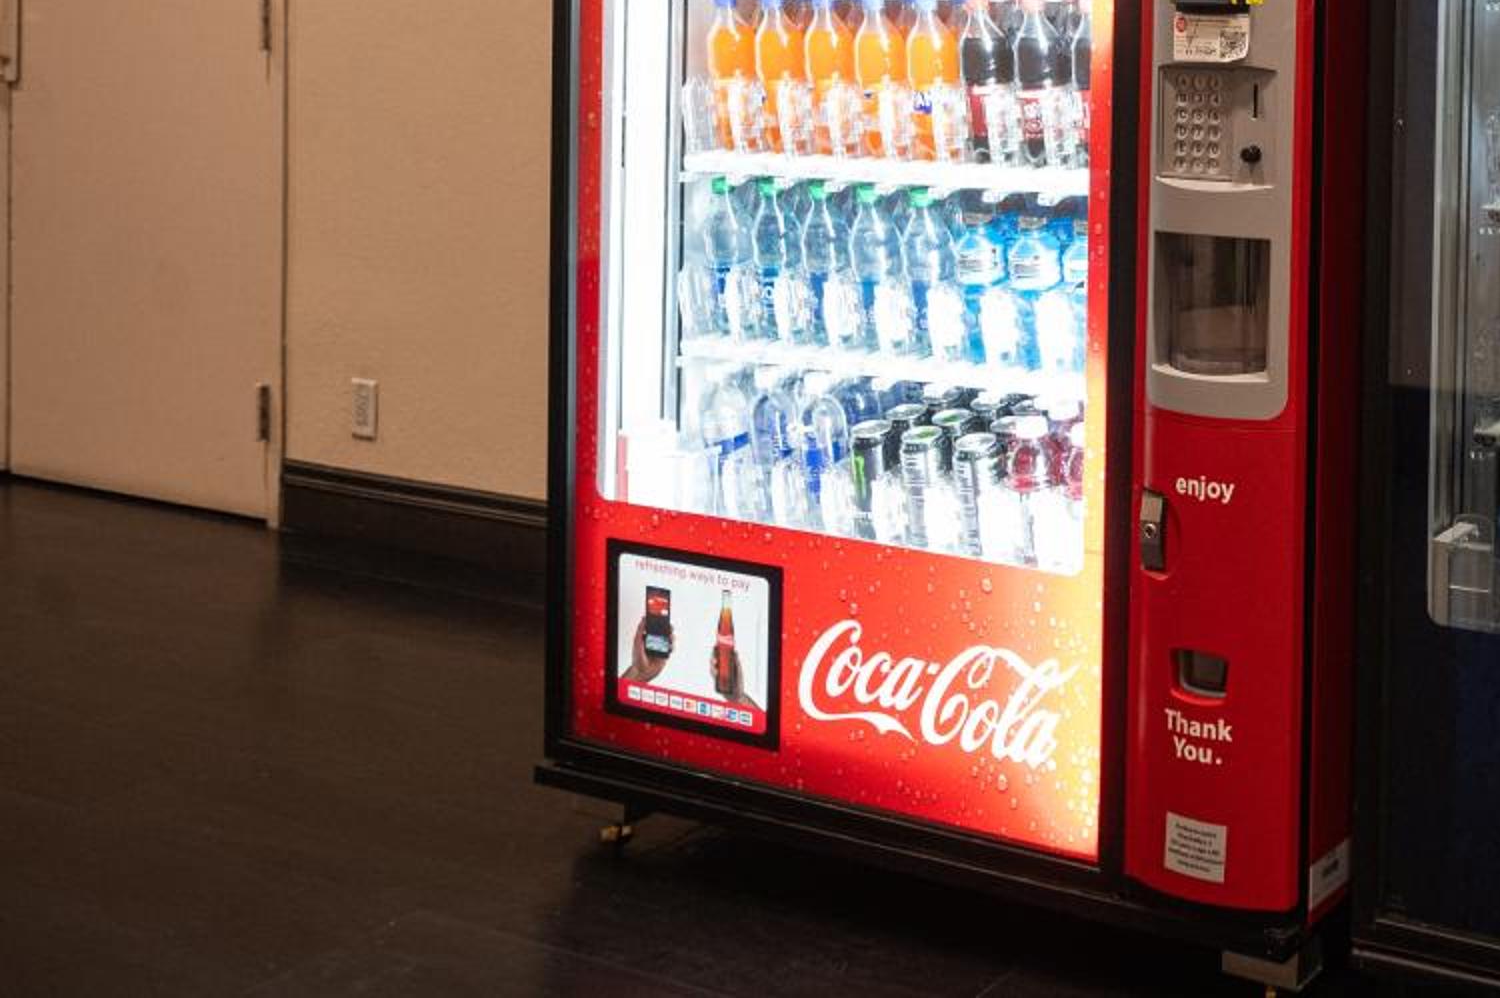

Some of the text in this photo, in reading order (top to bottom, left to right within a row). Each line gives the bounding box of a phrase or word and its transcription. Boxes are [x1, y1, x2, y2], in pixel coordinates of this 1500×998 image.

[1175, 475, 1235, 504] enjoy
[798, 619, 1082, 770] Coca-Cola
[1165, 708, 1233, 743] Thank
[1173, 736, 1223, 765] You.
